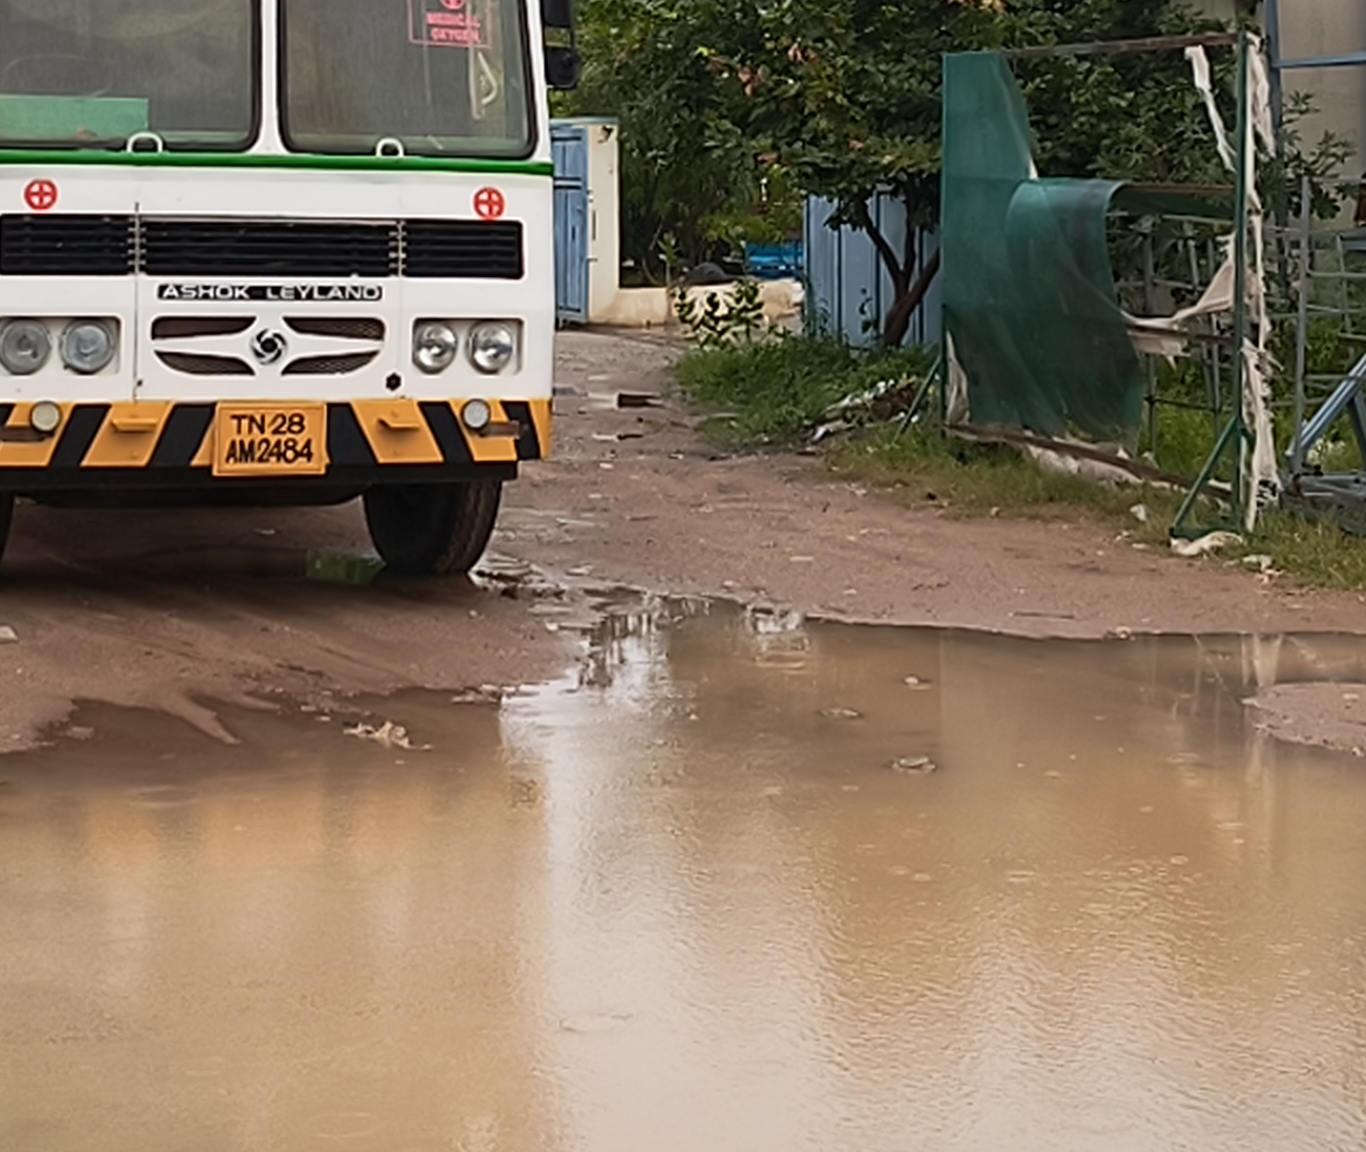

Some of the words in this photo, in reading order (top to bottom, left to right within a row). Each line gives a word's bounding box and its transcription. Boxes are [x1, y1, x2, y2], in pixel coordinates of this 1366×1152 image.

[430, 28, 481, 44] OXYGEN
[162, 284, 250, 299] ASHOK
[266, 285, 381, 300] LEYLAND
[230, 413, 265, 435] TN
[267, 413, 305, 435] 28
